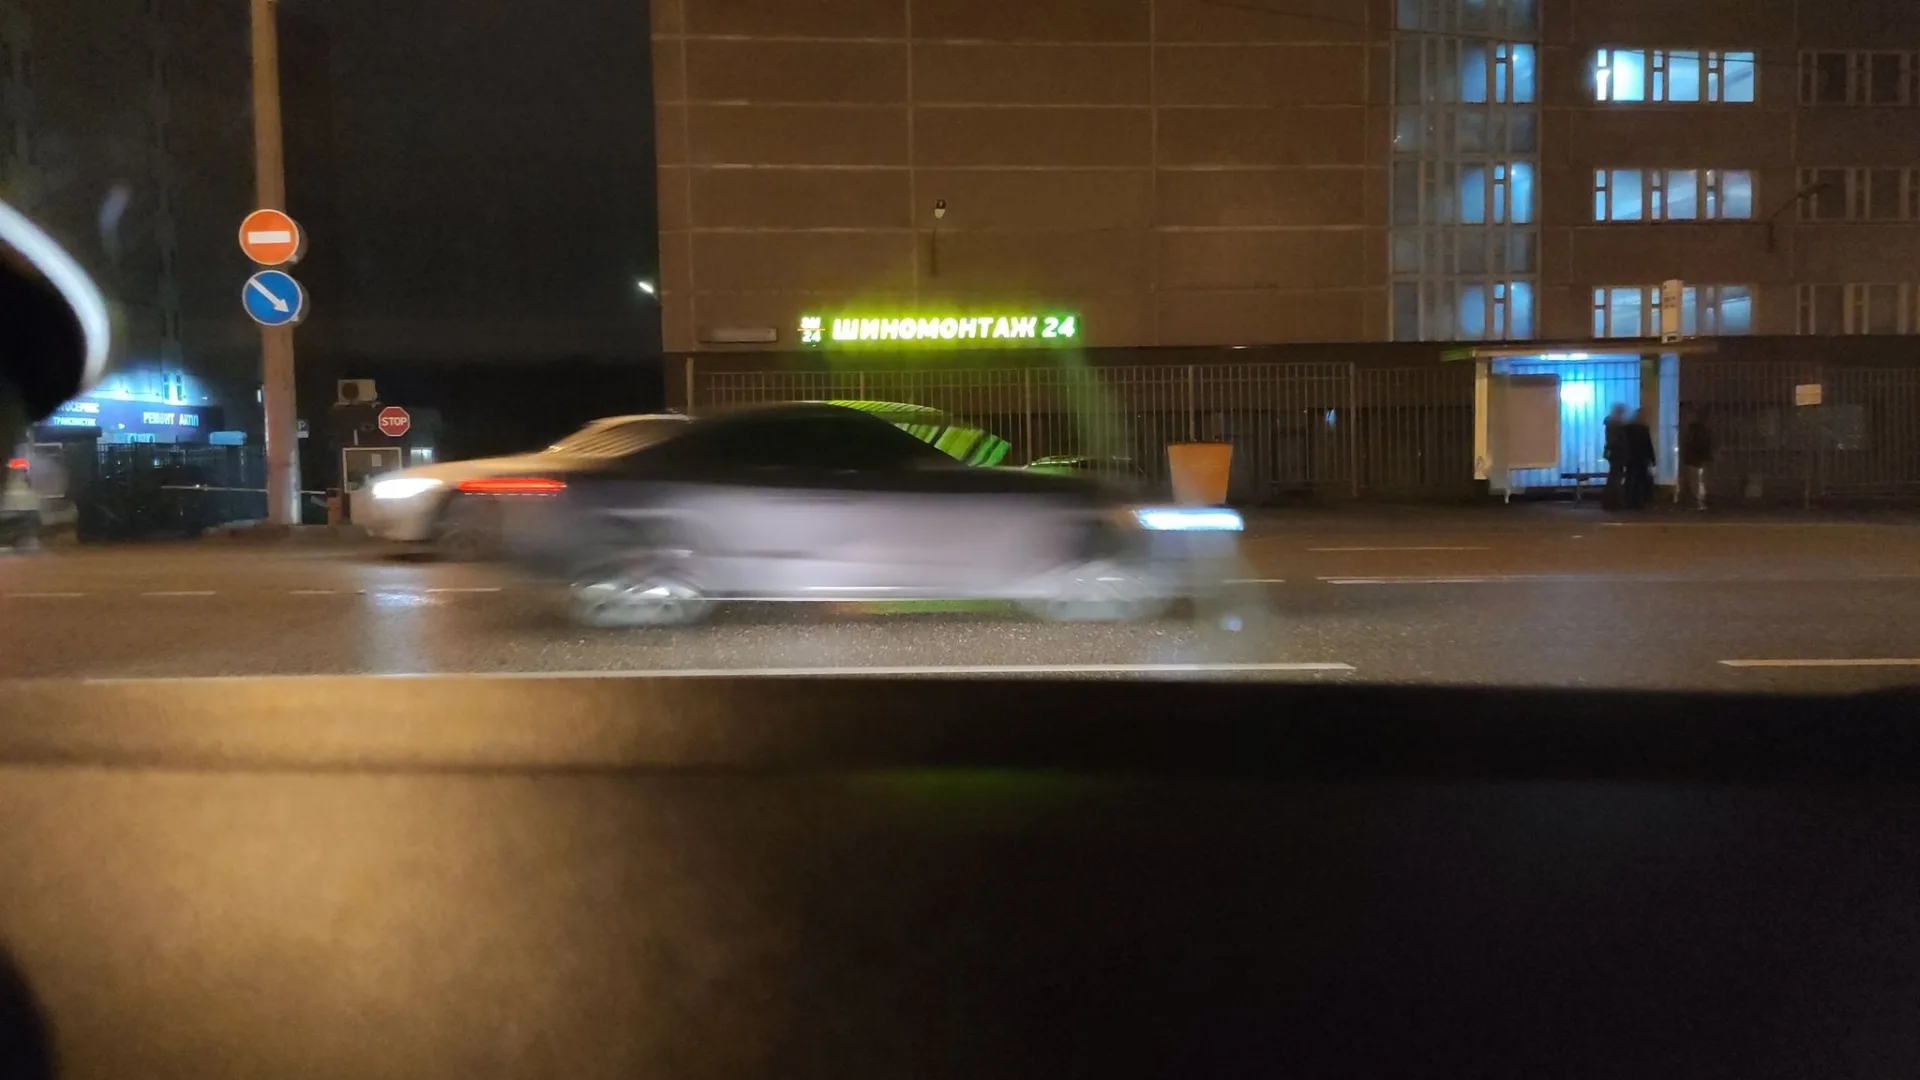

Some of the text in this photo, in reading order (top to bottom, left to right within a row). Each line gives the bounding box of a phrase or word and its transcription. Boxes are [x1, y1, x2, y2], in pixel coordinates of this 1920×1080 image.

[832, 315, 1038, 340] ШИНОМОНТАЖ
[1041, 316, 1077, 338] 24
[143, 411, 175, 425] РЕМОНТ
[381, 416, 408, 426] STOP
